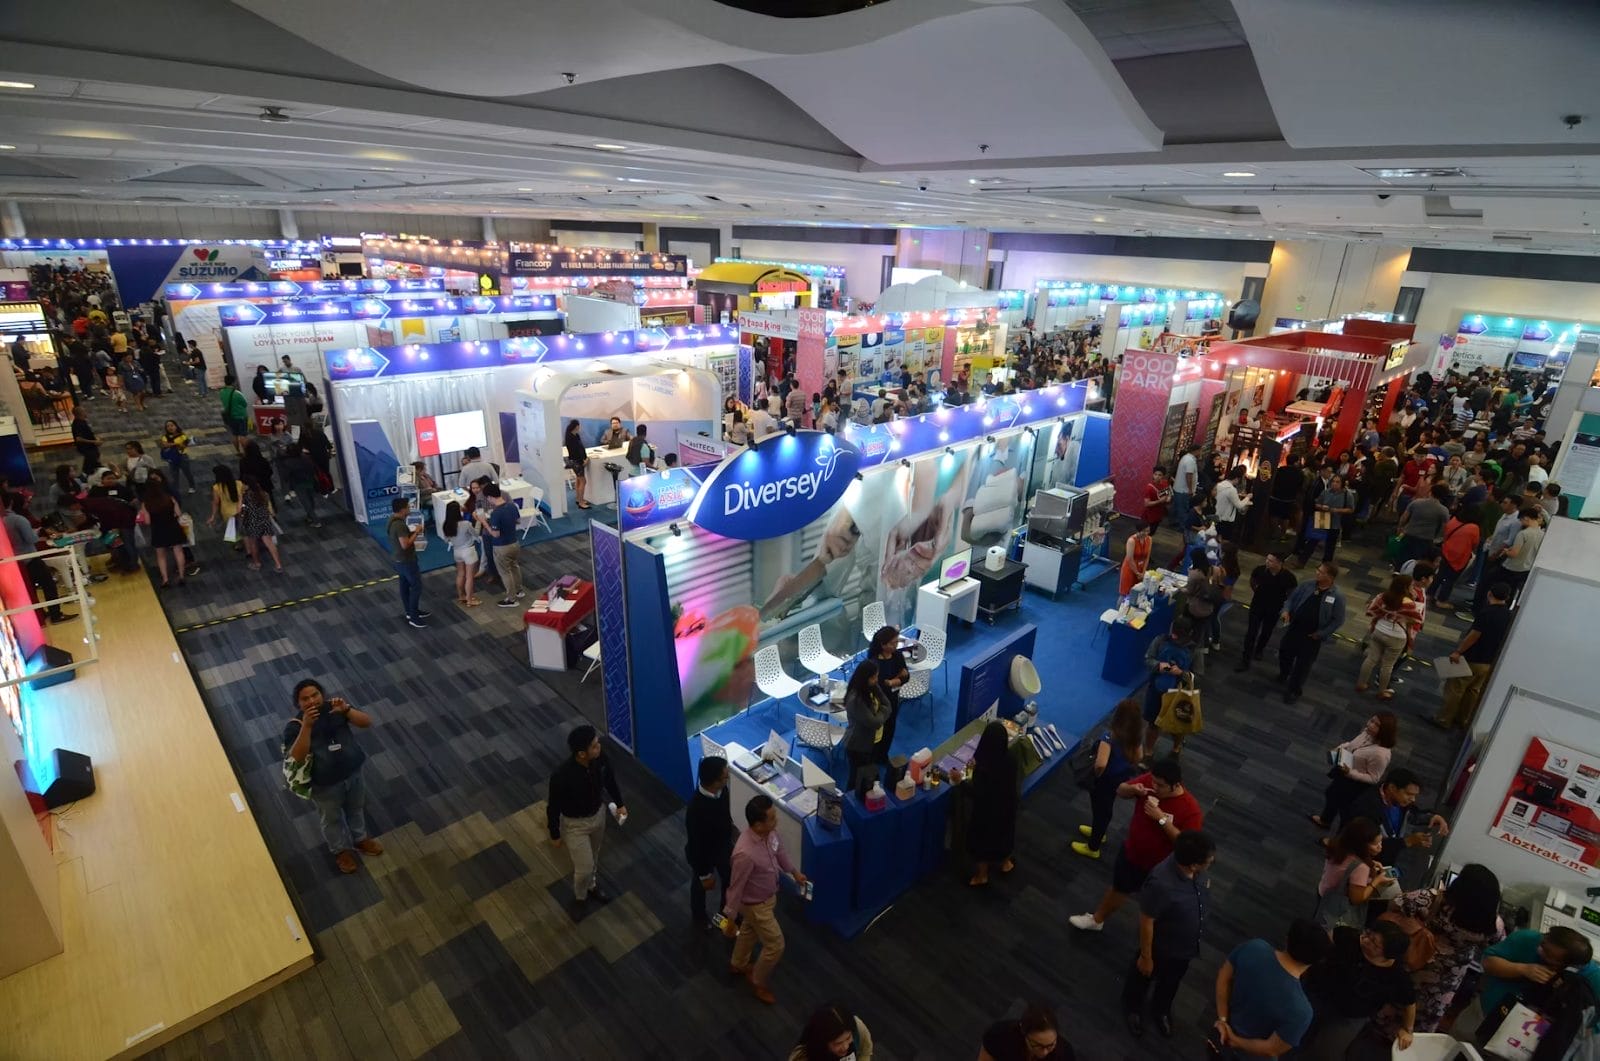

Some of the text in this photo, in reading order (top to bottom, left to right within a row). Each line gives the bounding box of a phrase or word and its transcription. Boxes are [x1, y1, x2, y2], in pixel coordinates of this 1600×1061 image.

[515, 259, 552, 269] Francorp
[180, 266, 238, 276] SUZUMO
[799, 311, 825, 323] FOOD
[799, 323, 825, 335] PARK
[254, 338, 290, 346] LOYALTY
[1123, 354, 1174, 374] FOOD
[1120, 370, 1169, 391] PARK
[369, 486, 398, 497] OKTO
[724, 469, 823, 516] Diversey
[1500, 833, 1560, 862] Abztrak
